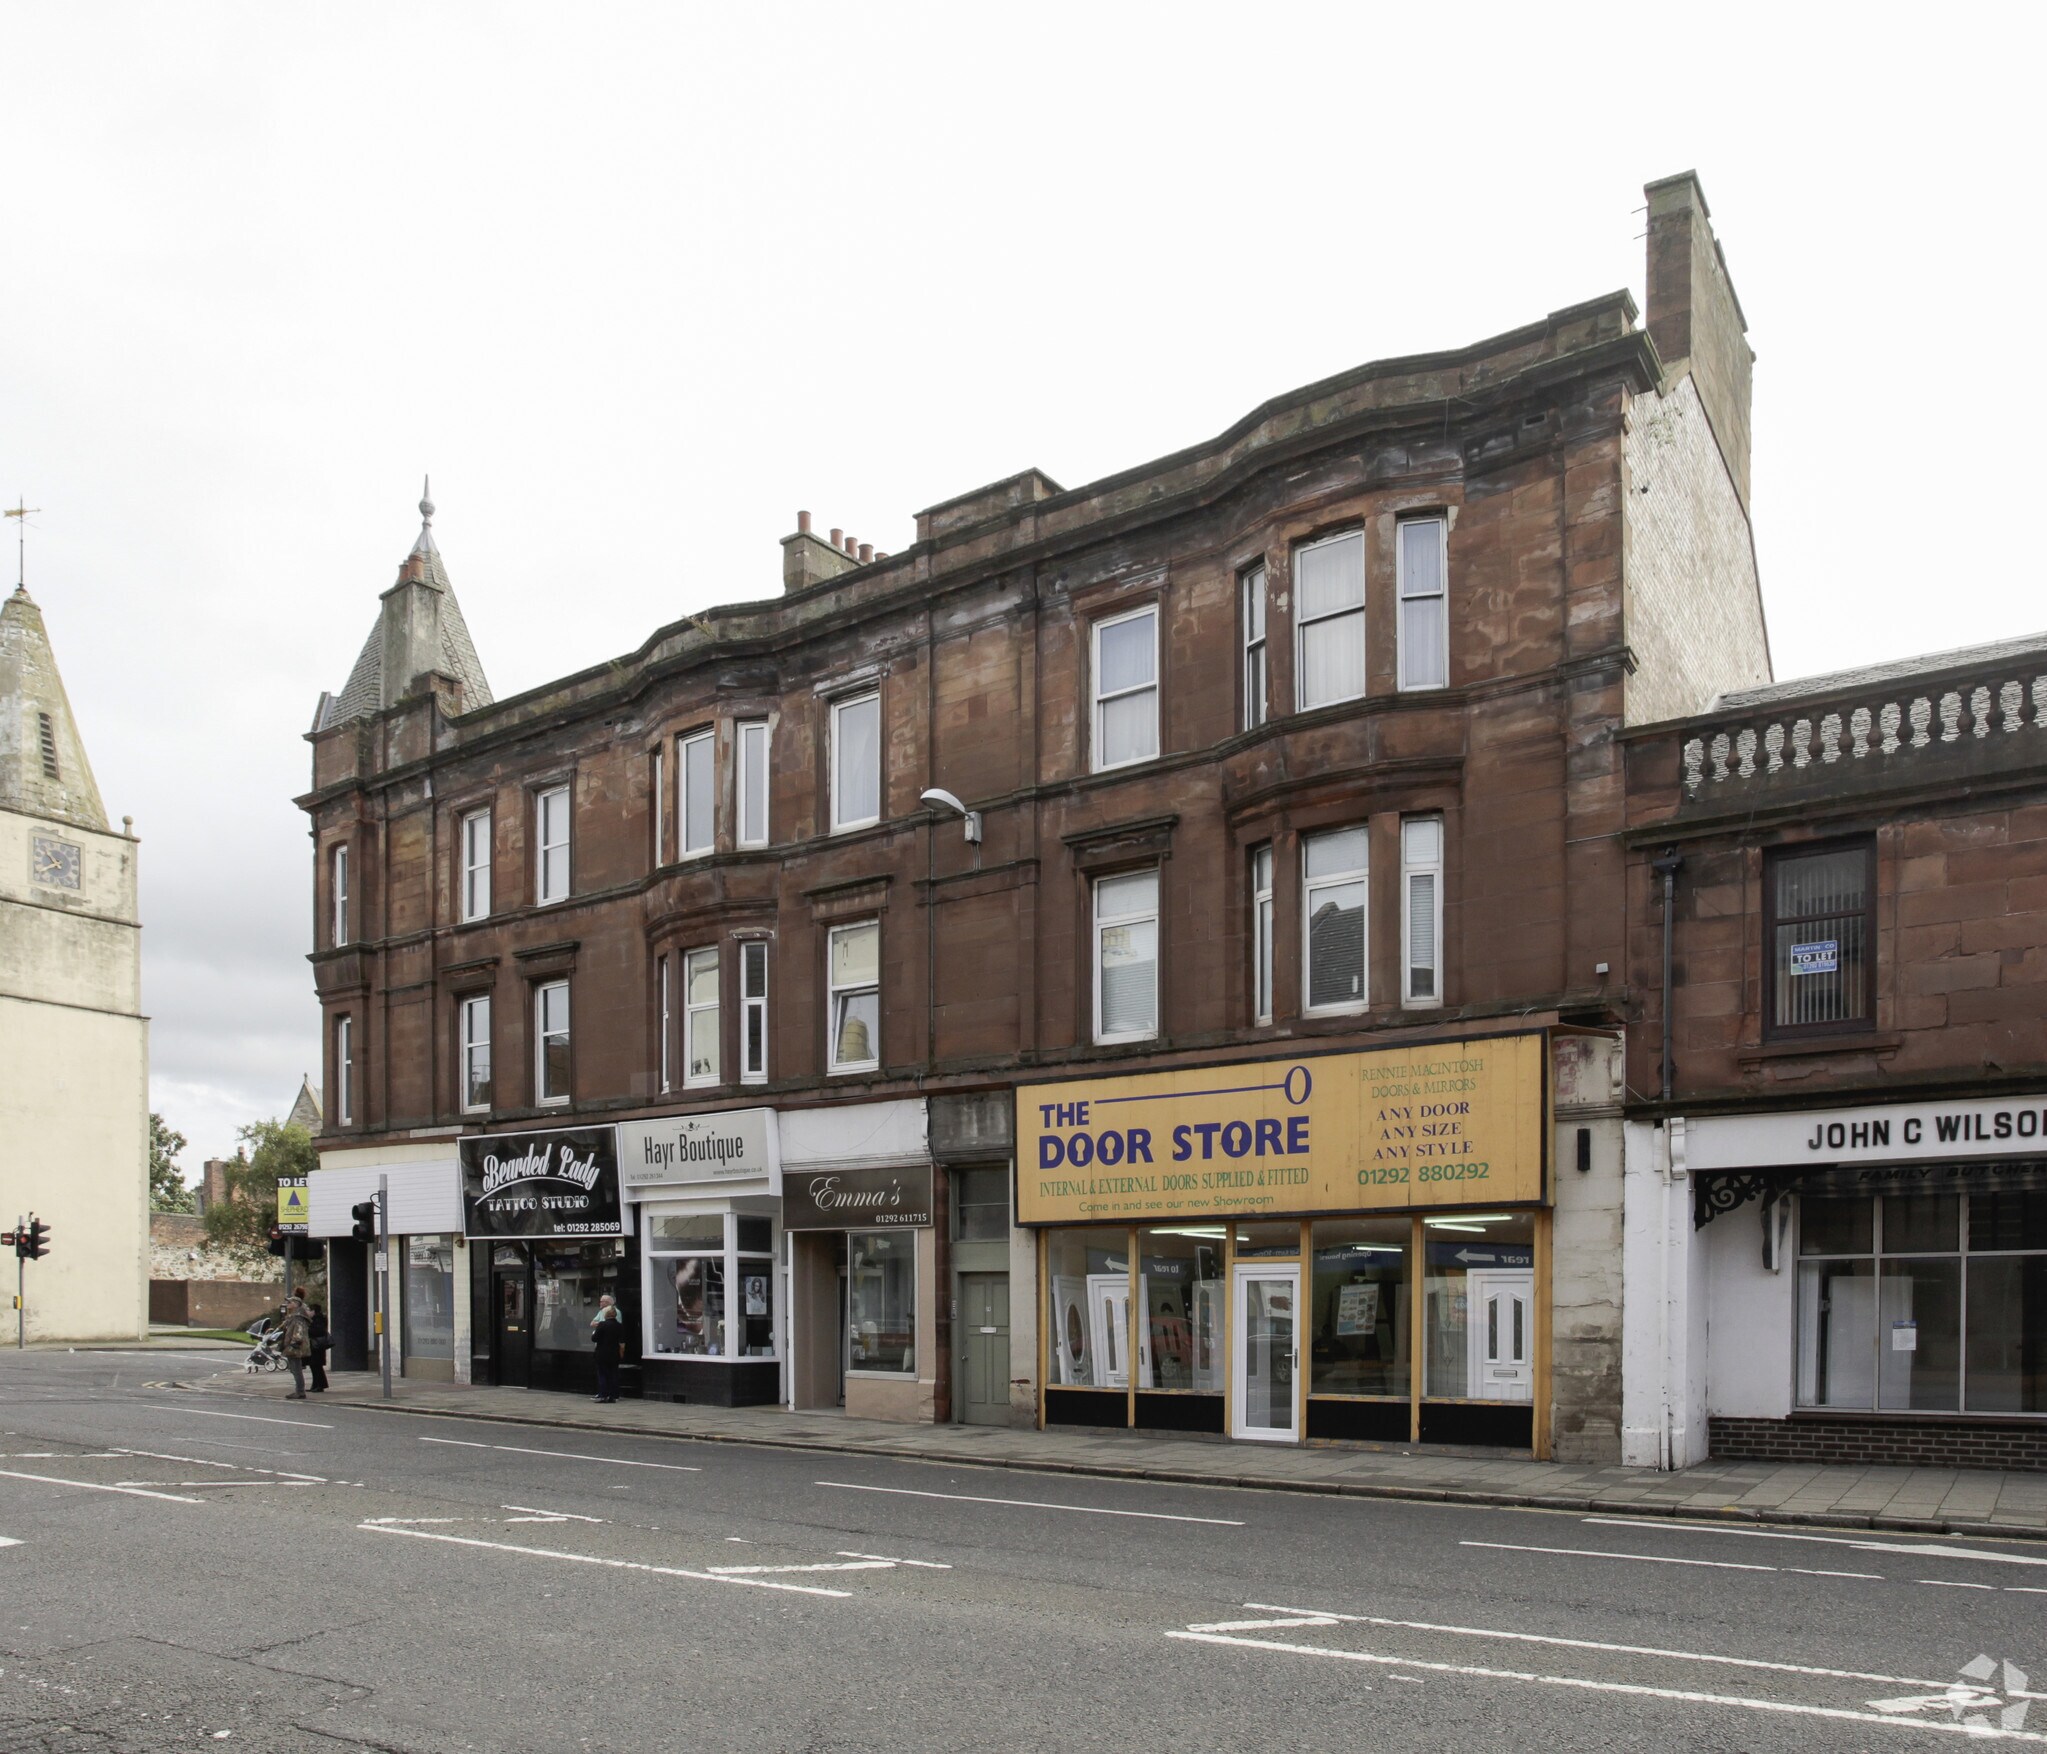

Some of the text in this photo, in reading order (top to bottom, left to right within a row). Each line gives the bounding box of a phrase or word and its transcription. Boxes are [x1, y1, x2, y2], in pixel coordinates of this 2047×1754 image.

[1797, 952, 1832, 963] TO LET
[1362, 1059, 1484, 1081] RENNIE MACINTOSH
[1372, 1078, 1476, 1098] DOORS & MIRRORS
[1039, 1101, 1090, 1128] THE
[1377, 1102, 1470, 1121] ANY DOOR
[1380, 1122, 1462, 1140] ANY SIZE
[1808, 1110, 2047, 1150] JOHN C WILSO
[644, 1131, 744, 1170] Hayr Boutique
[1039, 1116, 1310, 1170] DOOR STORE
[1372, 1141, 1474, 1160] ANY STYLE
[483, 1143, 600, 1192] Bearded Lady
[1358, 1162, 1489, 1185] 01292 880292
[1858, 1168, 1932, 1181] FAMILY
[278, 1178, 308, 1186] TO LET
[1040, 1167, 1309, 1198] INTERNAL & EXTERNAL DOORS SUPPLIED & FITTED
[487, 1195, 589, 1211] TATTOO STUDIO
[809, 1177, 901, 1211] Emma's
[1079, 1195, 1274, 1212] Come in and see our new Showroom
[554, 1222, 620, 1232] tel: 01292 285069
[876, 1213, 927, 1223] 01292 611715
